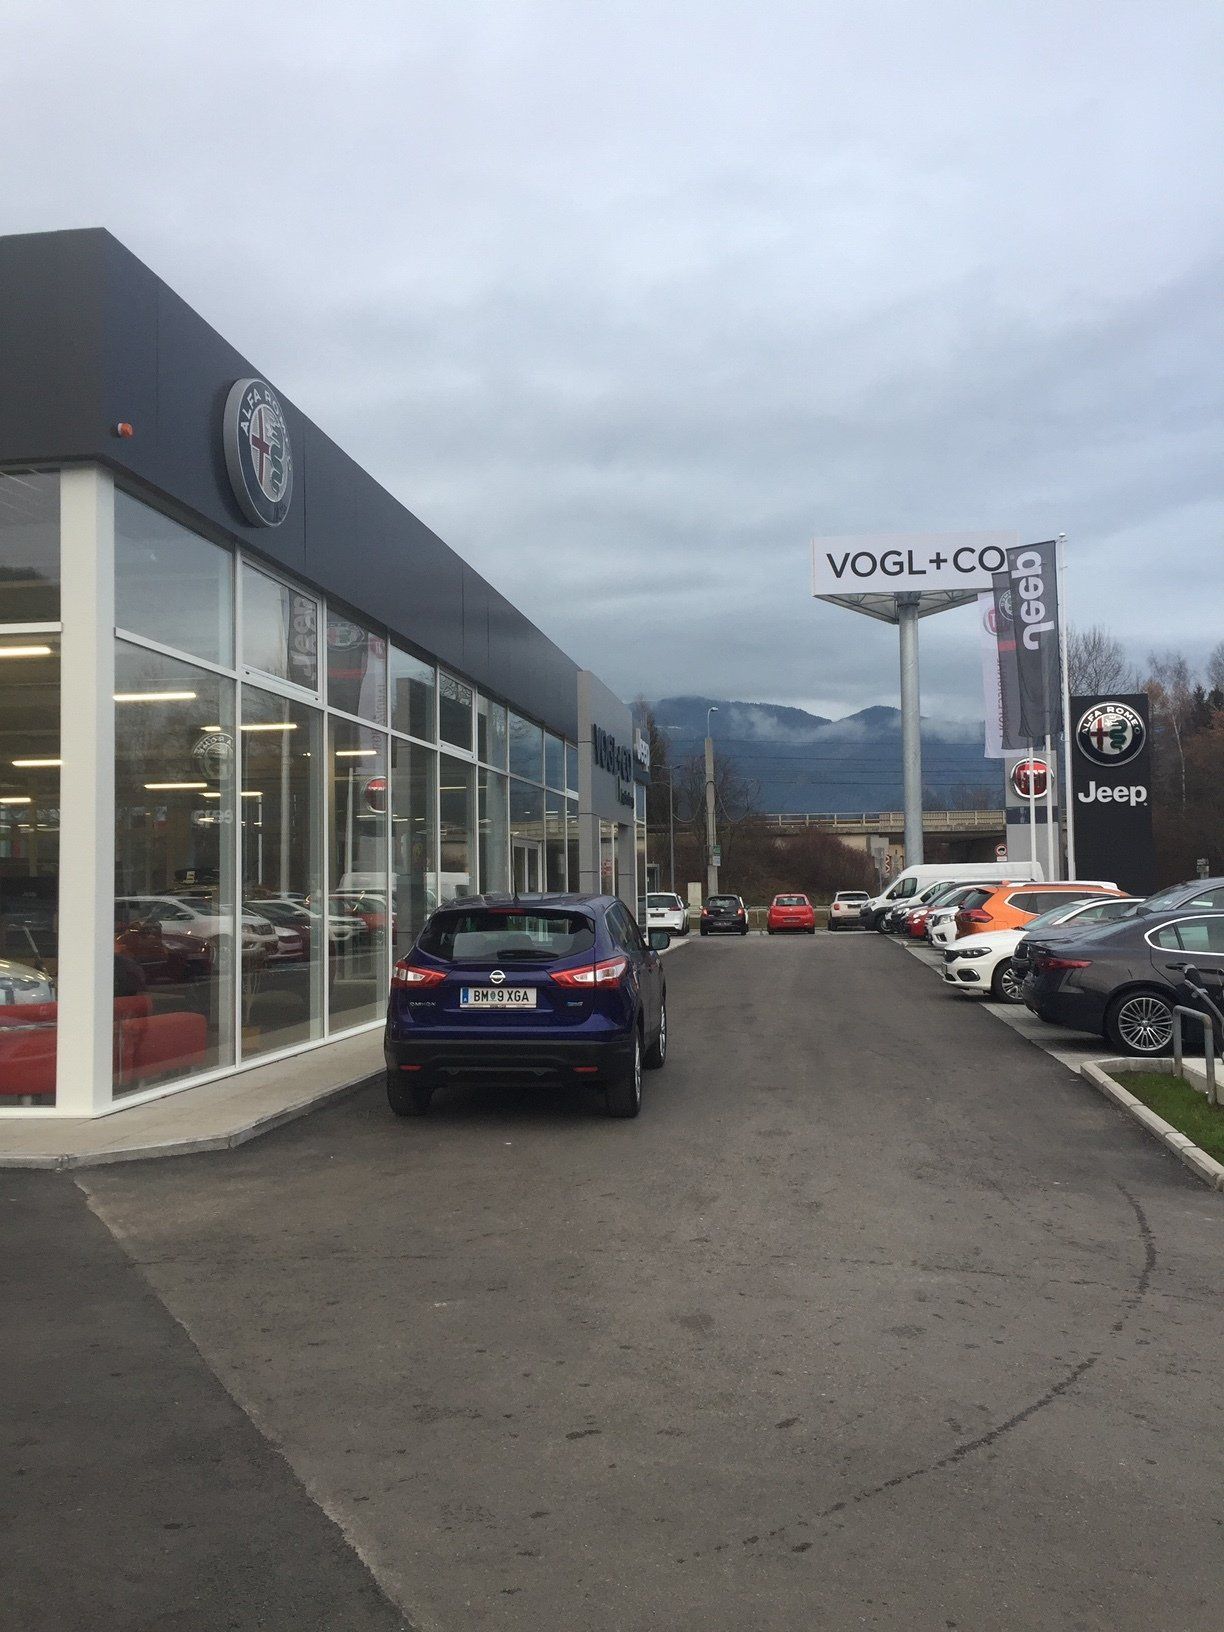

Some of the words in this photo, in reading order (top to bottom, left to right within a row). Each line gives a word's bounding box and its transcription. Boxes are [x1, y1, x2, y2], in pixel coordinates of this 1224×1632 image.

[241, 388, 262, 436] ALFA
[826, 546, 1006, 579] VOGL+CO
[1081, 710, 1103, 735] ALFA
[1106, 706, 1141, 734] ROMEO
[1078, 781, 1147, 806] Jeep
[473, 990, 489, 1002] BM
[497, 990, 504, 1002] 9
[507, 990, 530, 1002] XGA
